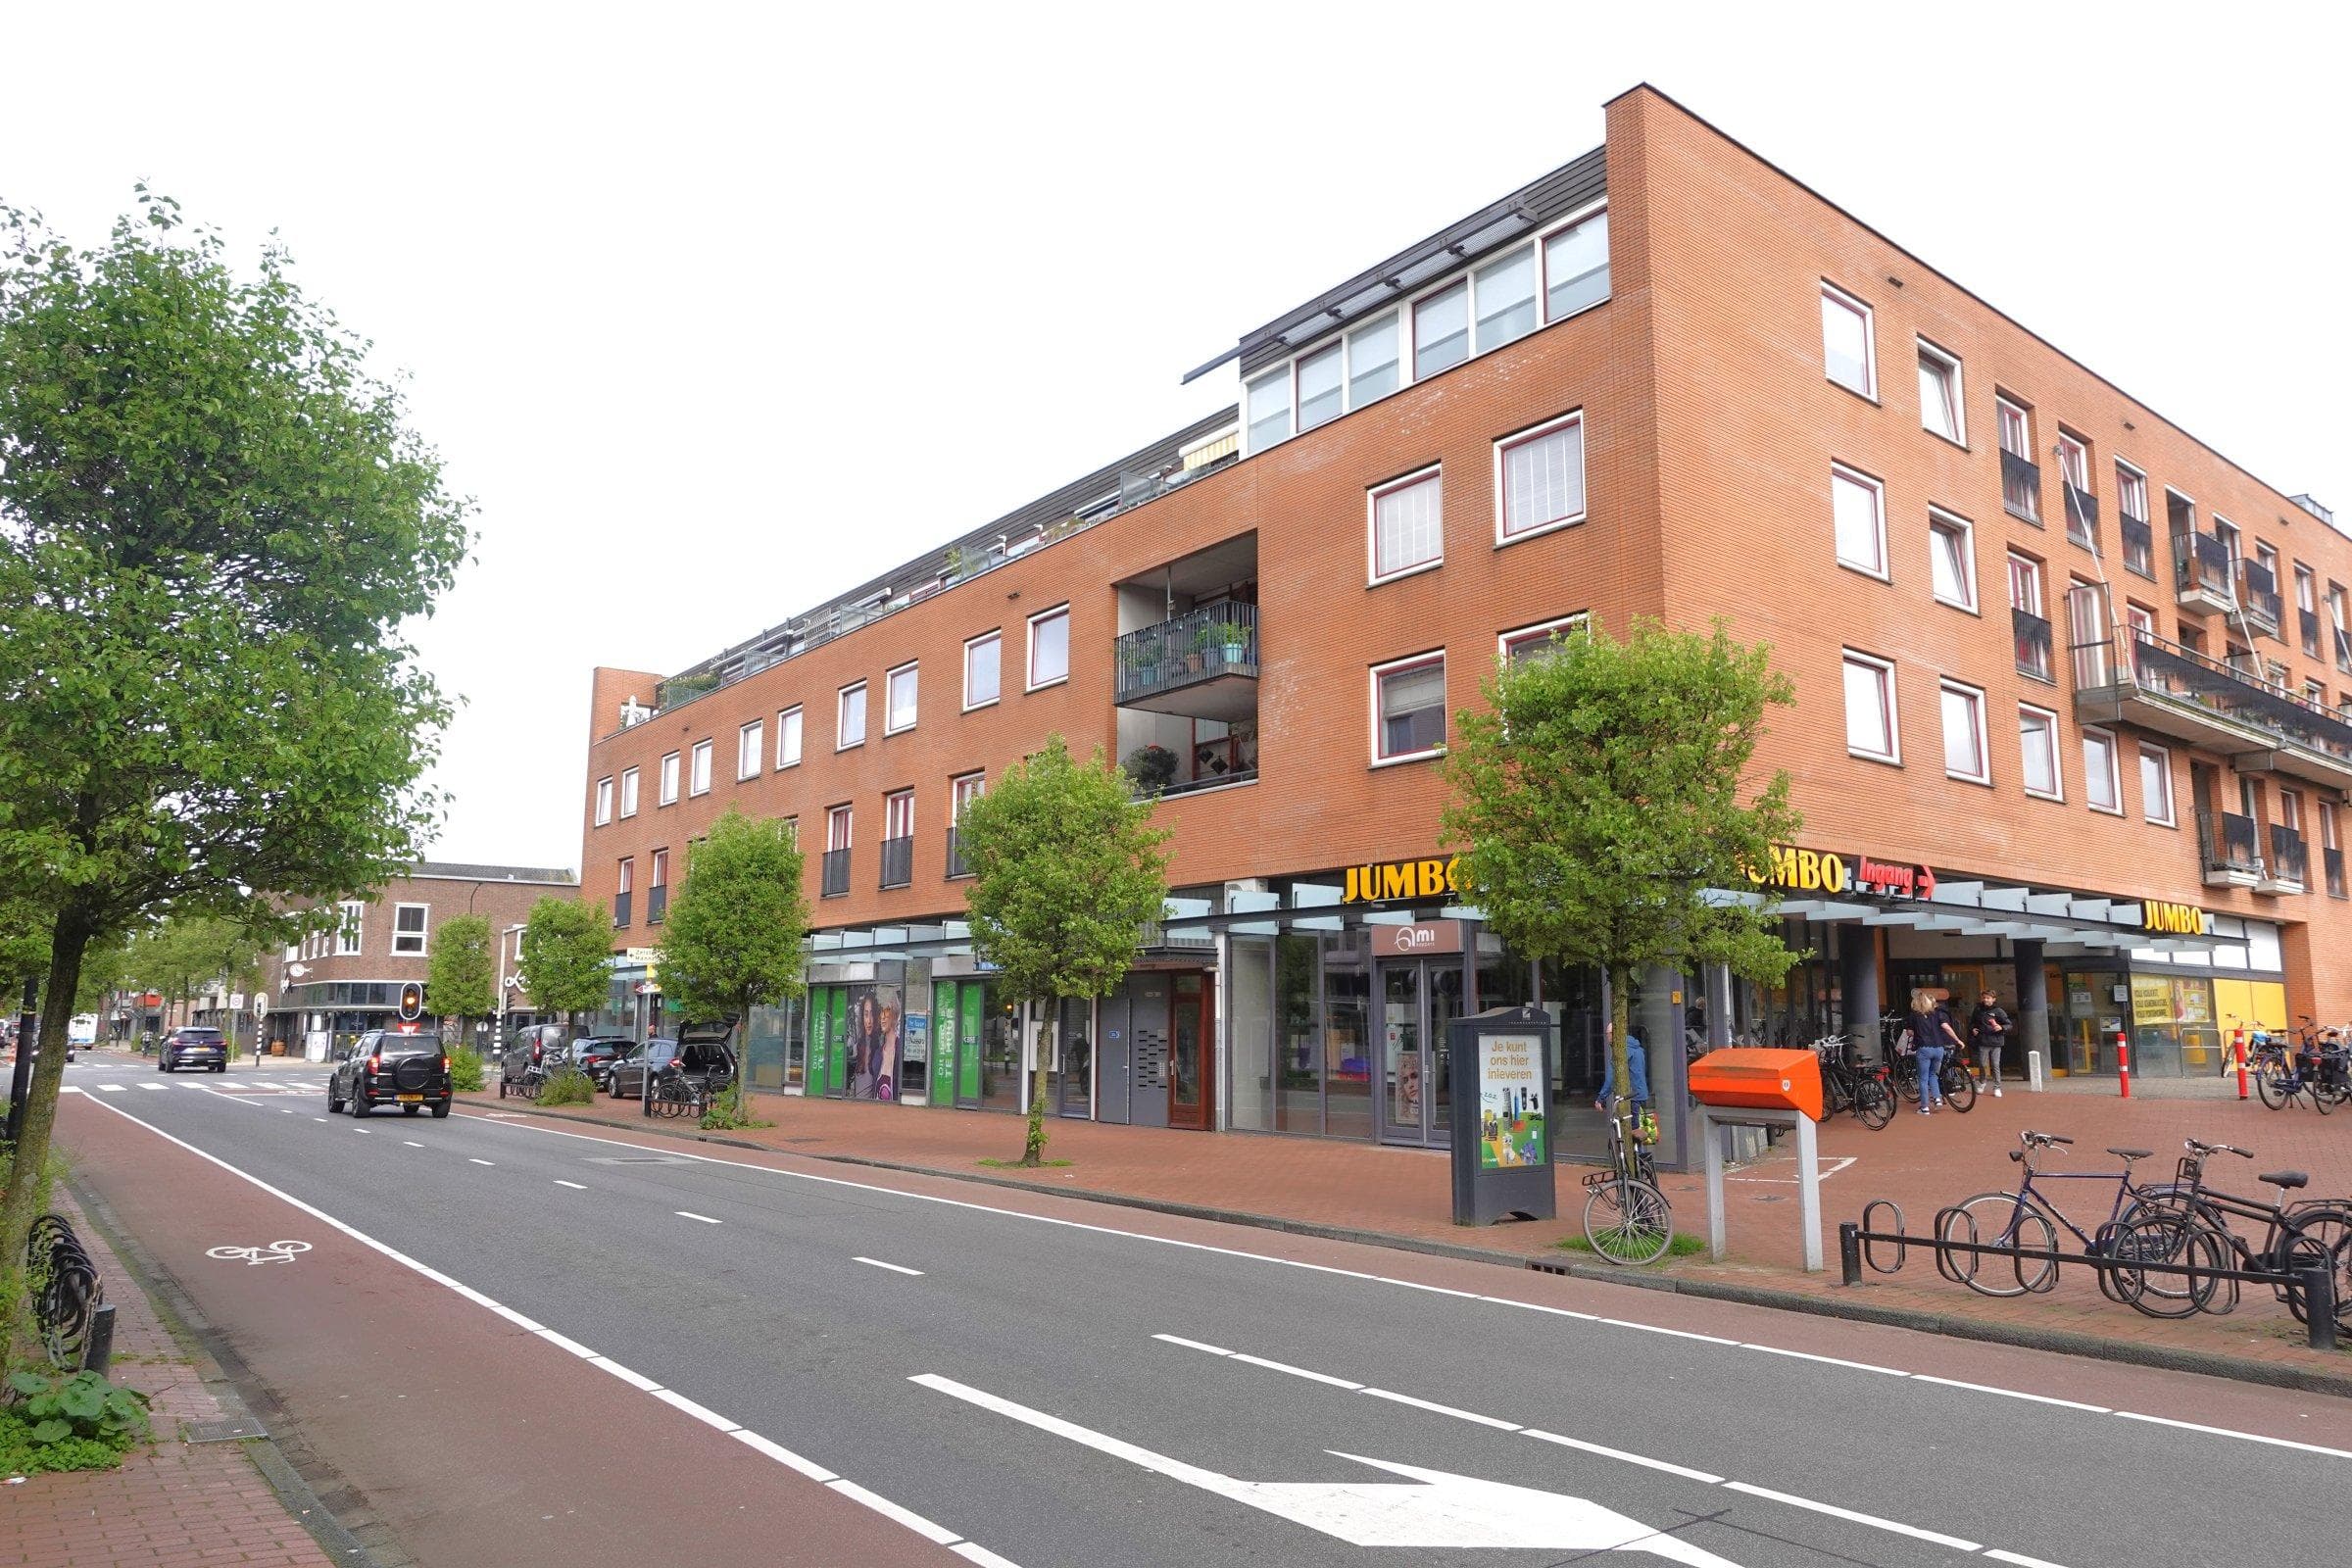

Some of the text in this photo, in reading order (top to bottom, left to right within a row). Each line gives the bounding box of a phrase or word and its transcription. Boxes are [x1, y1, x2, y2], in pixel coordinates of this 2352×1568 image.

[1740, 844, 1844, 894] MBO
[1860, 856, 1914, 895] Ingang
[2144, 901, 2203, 935] JUMBO
[1492, 1040, 1527, 1053] Je kunt
[945, 1057, 953, 1078] TE
[1491, 1054, 1529, 1066] ons hier
[1488, 1068, 1533, 1080] inleveren
